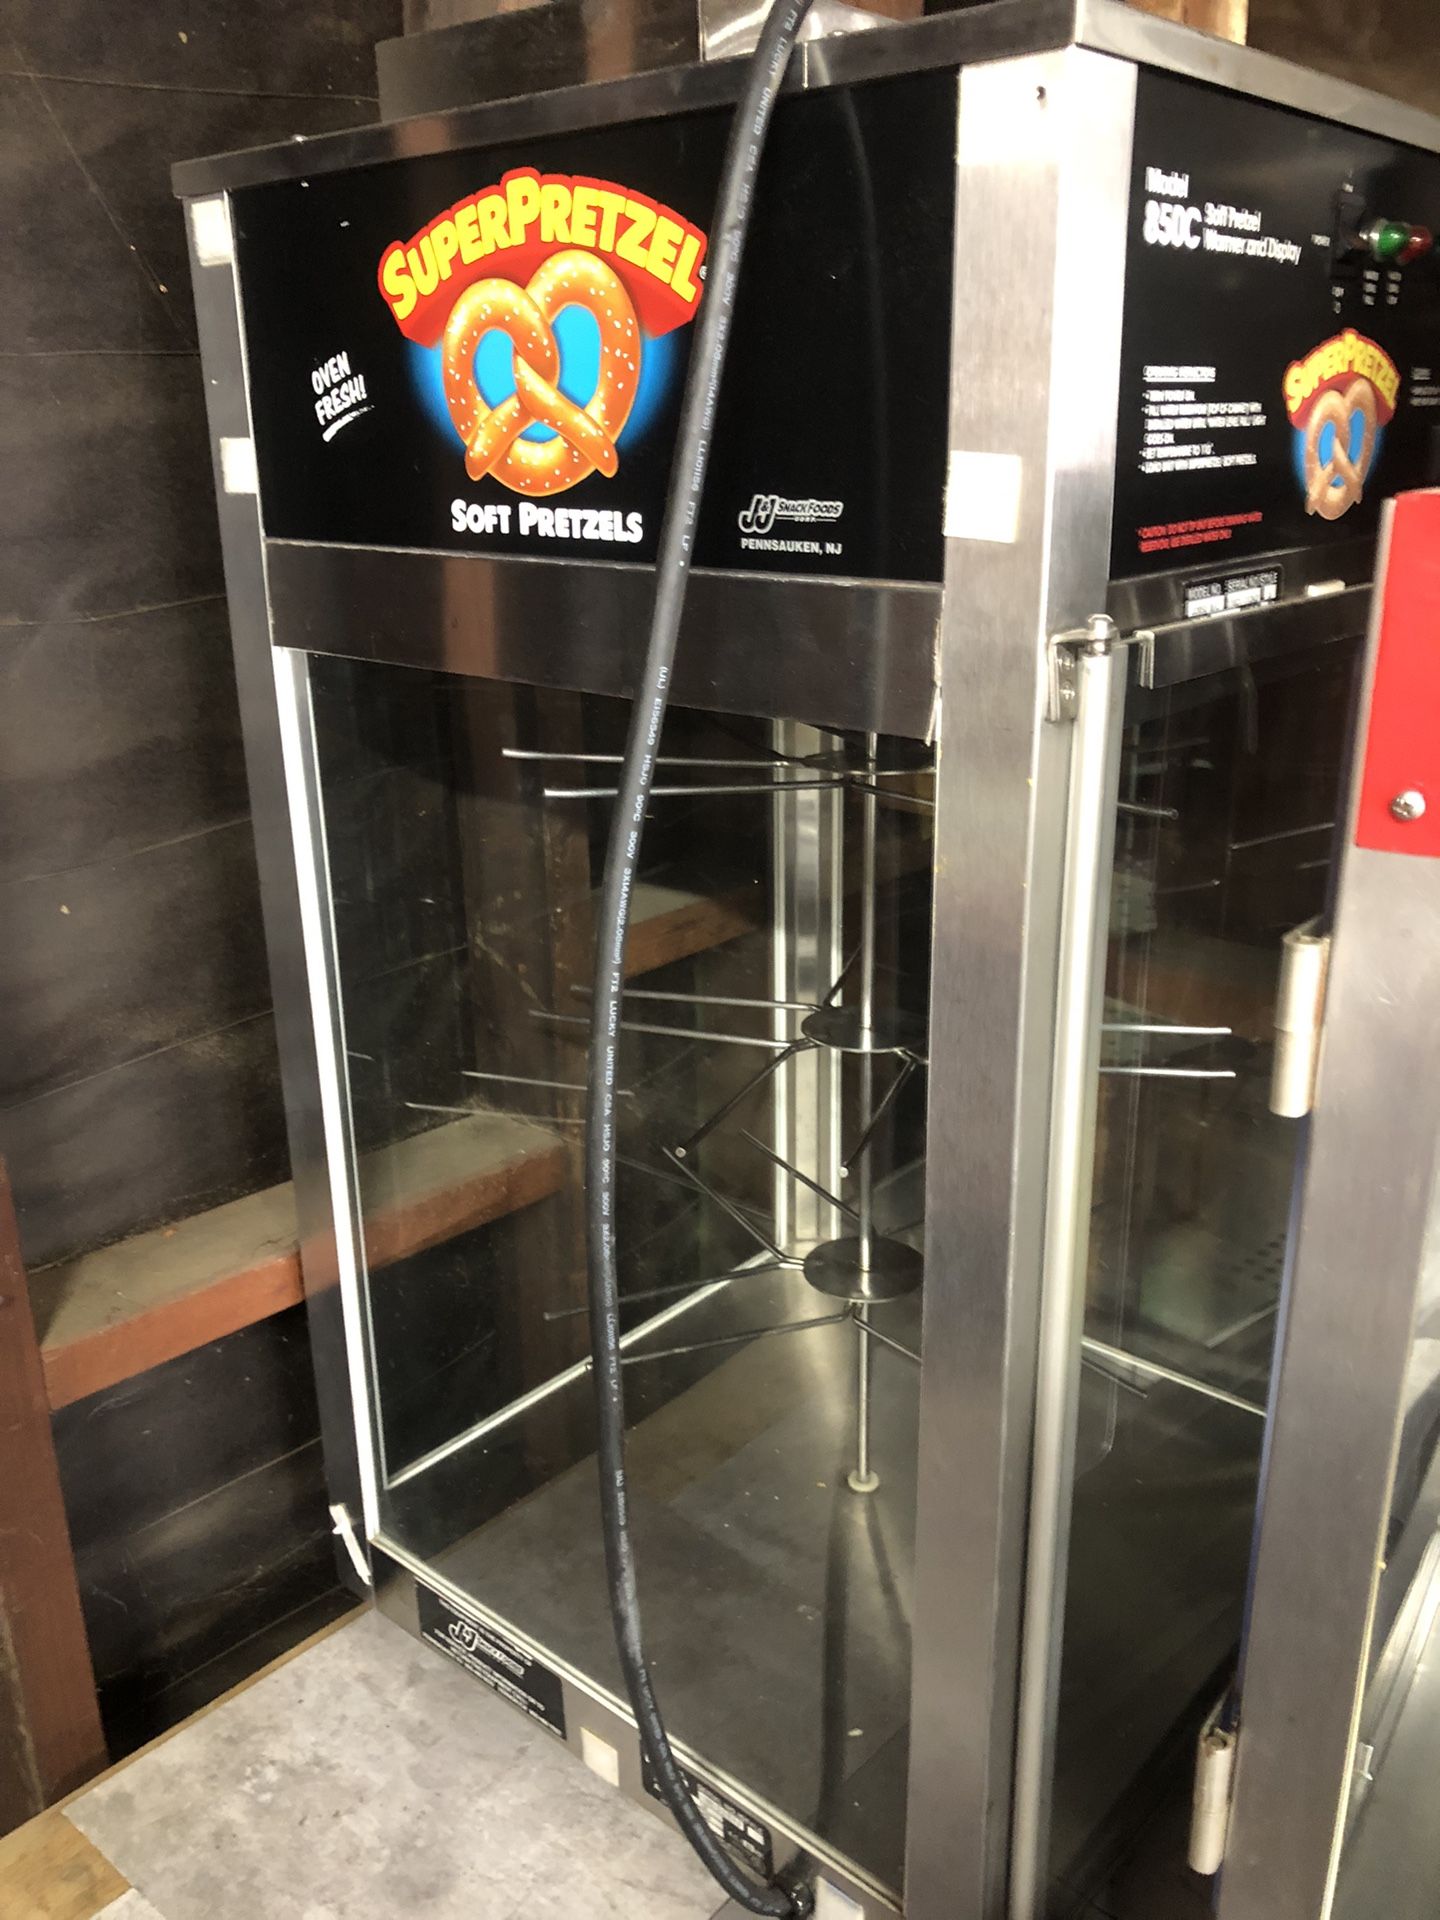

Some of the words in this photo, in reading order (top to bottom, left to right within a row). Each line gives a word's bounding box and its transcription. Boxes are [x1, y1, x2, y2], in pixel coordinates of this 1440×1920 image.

[754, 87, 772, 135] UNITED
[1145, 166, 1189, 199] Model
[1144, 200, 1202, 249] 850C
[1203, 202, 1228, 226] Soft
[1228, 206, 1262, 233] Pretzel
[382, 176, 702, 321] SUPERPRETZEL
[1246, 237, 1266, 259] and
[1266, 236, 1302, 266] Display
[311, 351, 351, 395] OVEN
[315, 374, 368, 426] FRESH!
[450, 498, 512, 534] SOFT
[518, 502, 644, 543] PRETZELS
[682, 534, 691, 551] LF
[740, 538, 823, 555] PENNSAUKEN,
[825, 542, 842, 555] NJ
[656, 666, 669, 690] (UL)
[639, 754, 652, 785] HSJO
[626, 831, 638, 859] 300V
[609, 971, 620, 992] FT2
[608, 1000, 618, 1036] LUCKY
[604, 1045, 614, 1085] UNITED
[603, 1093, 612, 1116] CSA
[602, 1123, 611, 1151] HSJO
[601, 1191, 610, 1216] 300V
